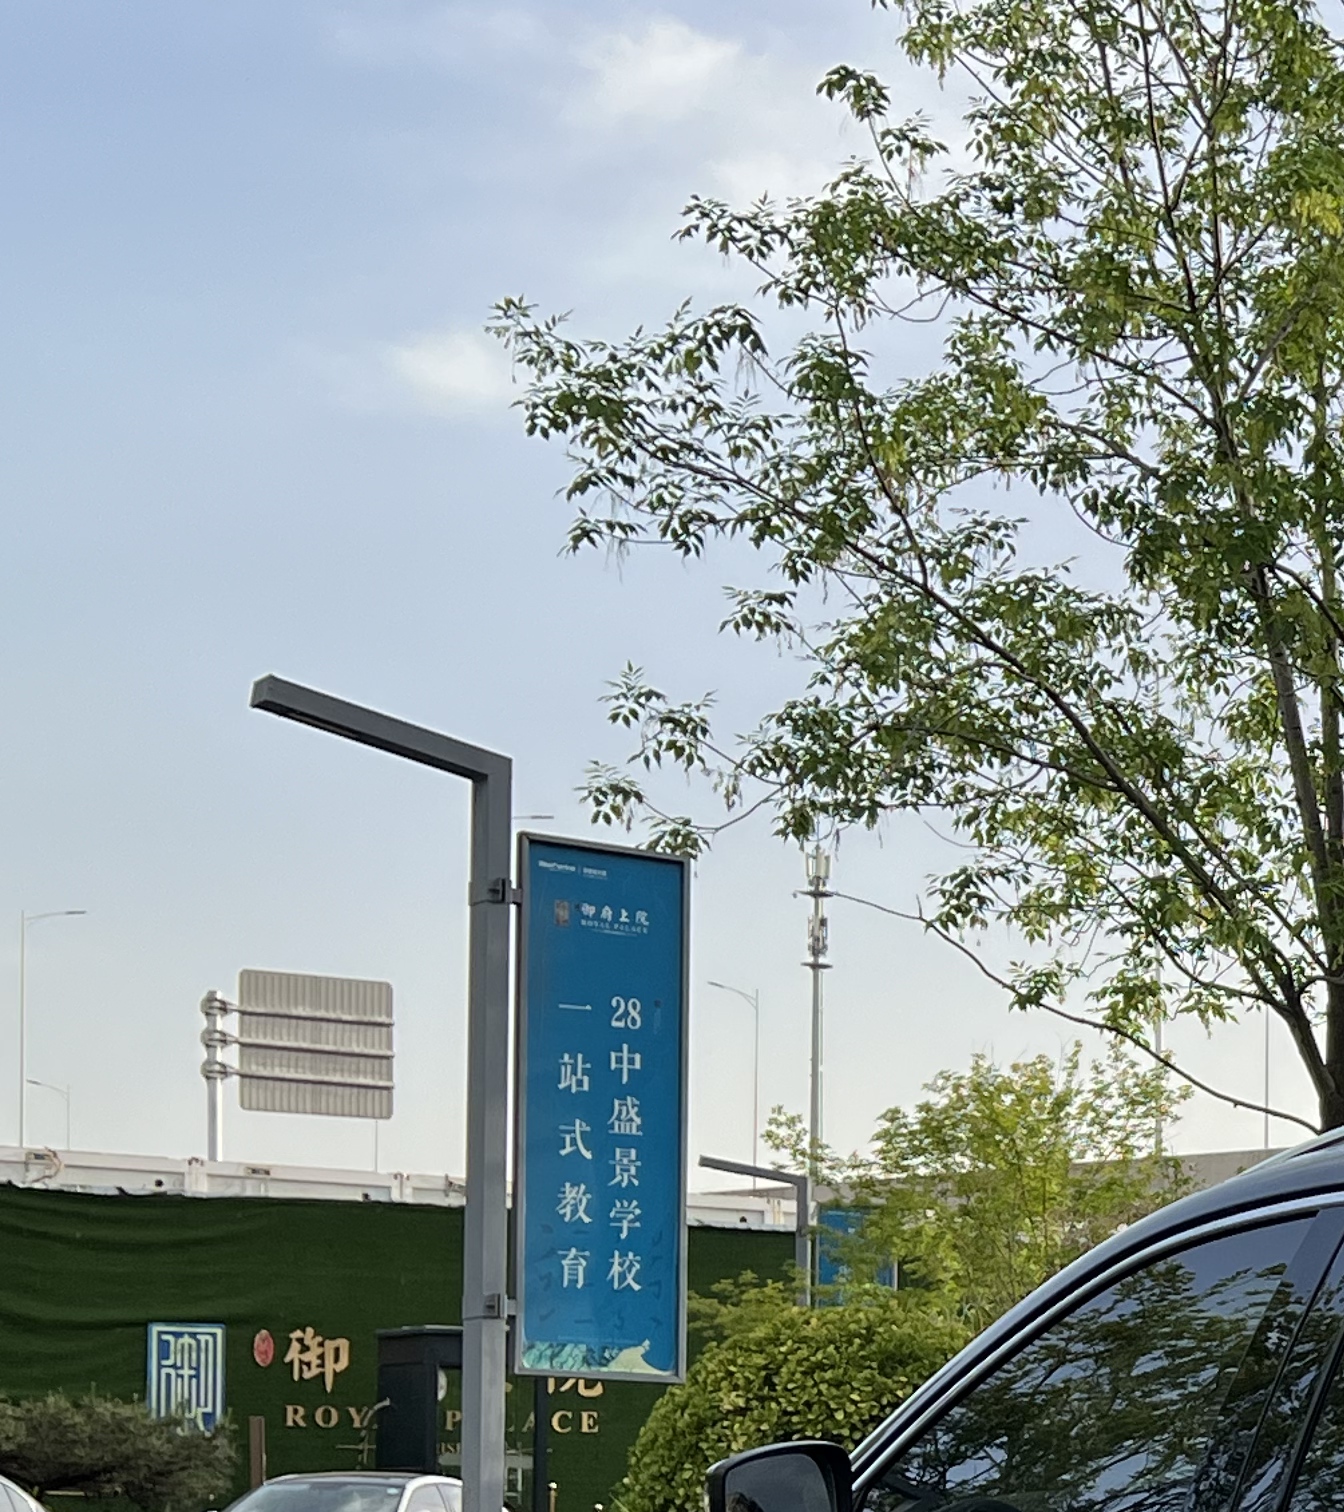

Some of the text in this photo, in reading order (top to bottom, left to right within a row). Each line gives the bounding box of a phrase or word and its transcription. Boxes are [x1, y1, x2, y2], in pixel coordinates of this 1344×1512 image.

[556, 1003, 593, 1289] 一站式教育
[607, 996, 643, 1291] 28中盛景学校
